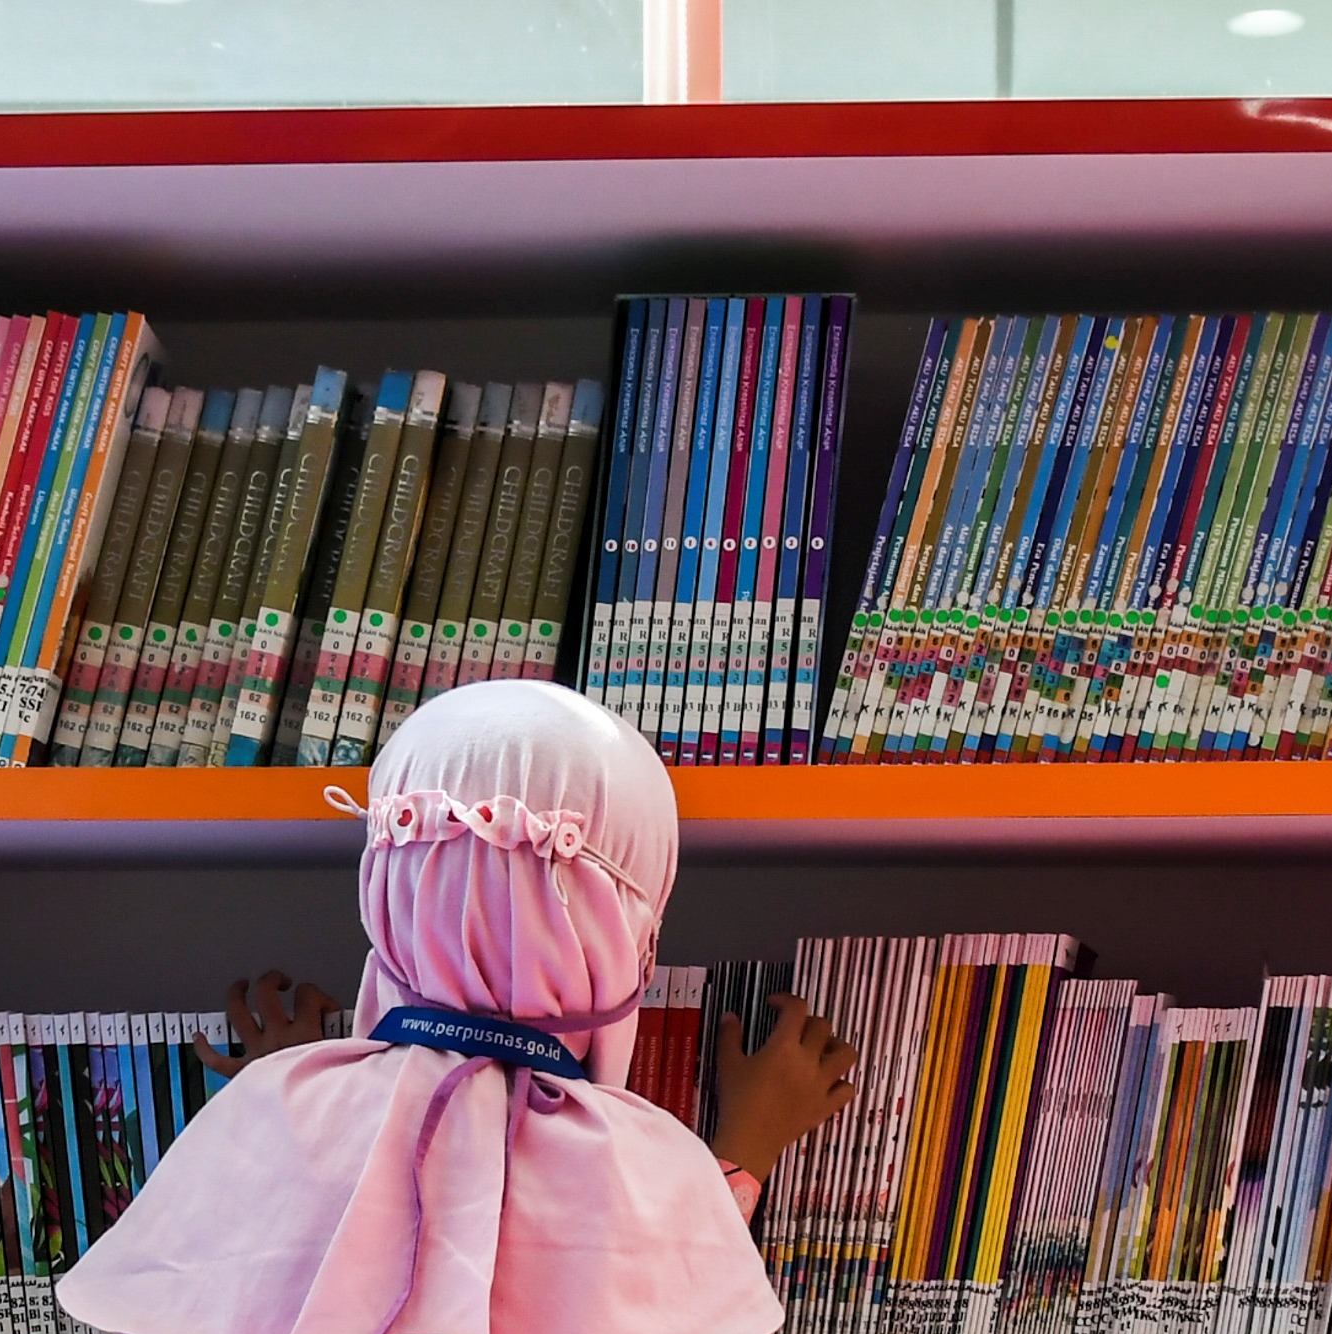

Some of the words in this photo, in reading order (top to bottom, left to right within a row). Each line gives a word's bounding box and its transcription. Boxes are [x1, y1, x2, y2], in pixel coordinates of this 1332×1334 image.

[223, 470, 266, 604] CHILDCRAFT
[376, 454, 419, 594] CHILDCRAFT
[482, 466, 522, 603] CHILDCRAFT
[515, 467, 553, 604] CHILDCRAFT
[544, 465, 583, 599] CHILDCRAFT
[401, 1017, 562, 1062] www.perpusnas.go.id
